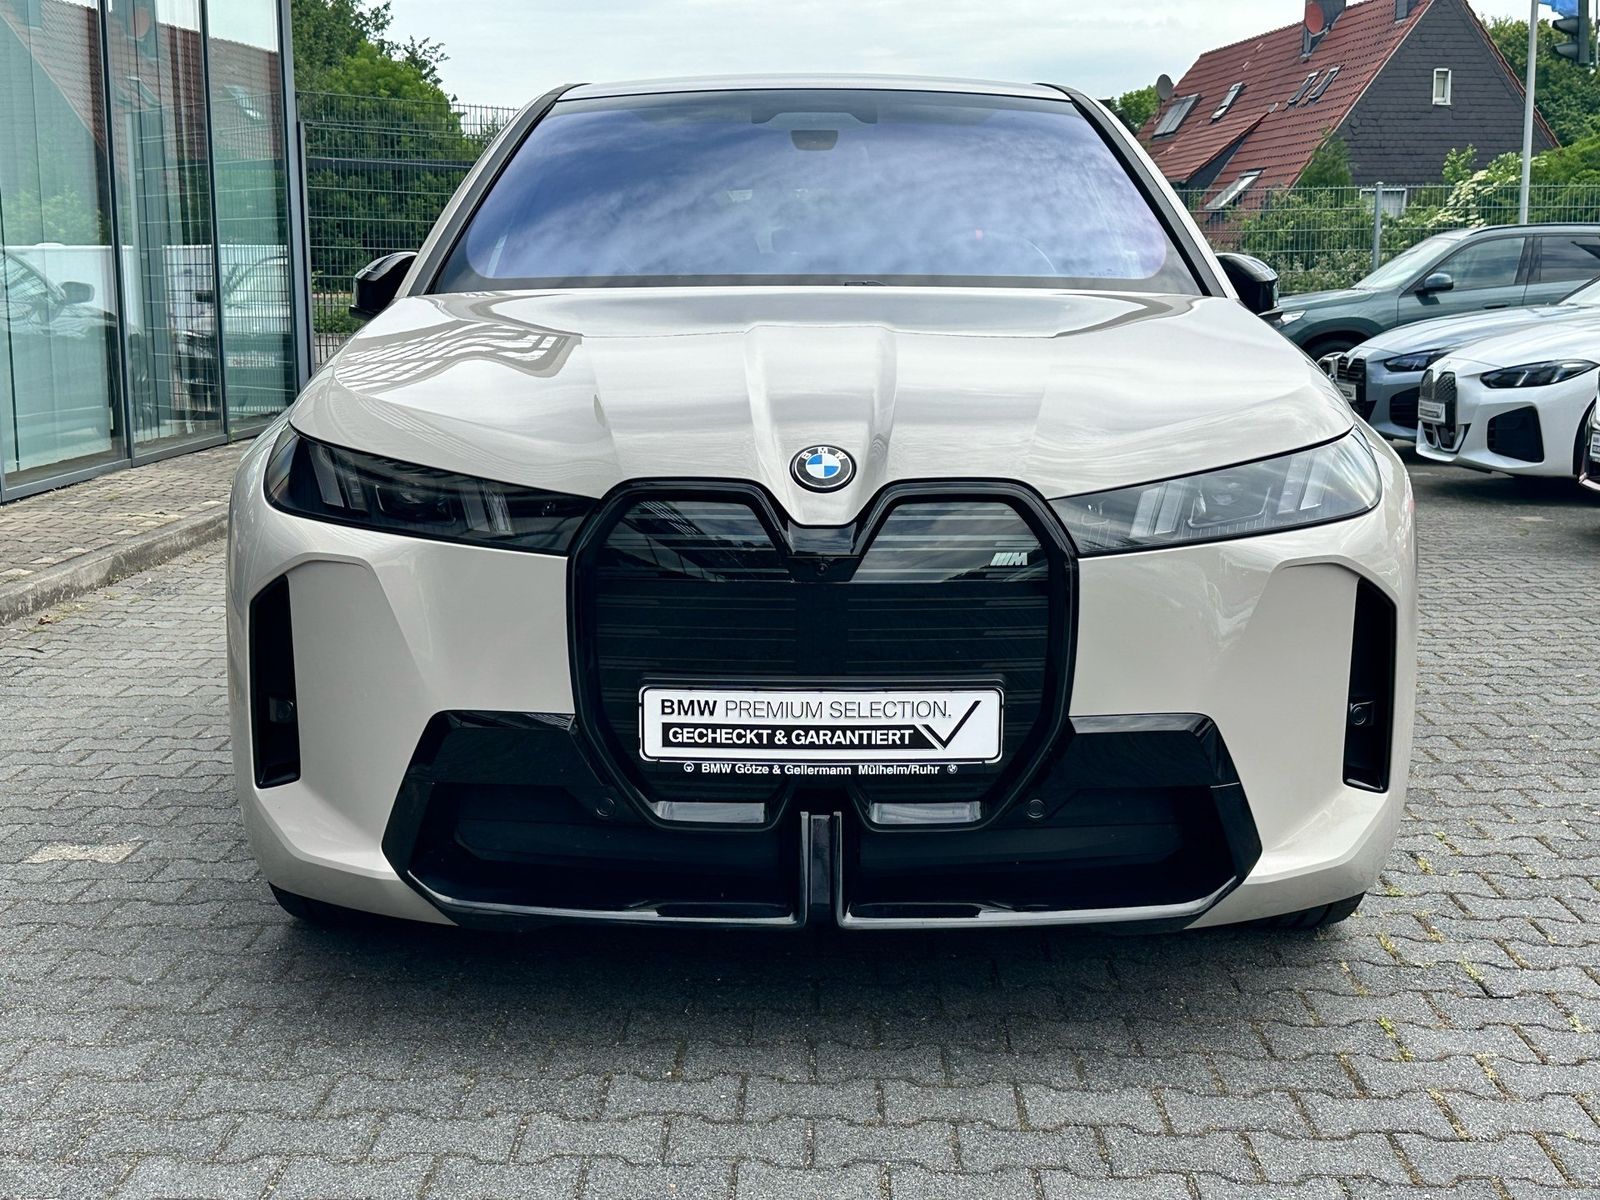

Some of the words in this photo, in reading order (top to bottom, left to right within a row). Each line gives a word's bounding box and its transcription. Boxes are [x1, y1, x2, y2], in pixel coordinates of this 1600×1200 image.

[801, 447, 847, 460] BMW
[660, 699, 718, 717] BMW
[725, 700, 823, 719] PREMIUM
[829, 700, 952, 719] SELECTION.
[668, 727, 772, 745] GECHECKT
[774, 730, 788, 745] &
[791, 729, 914, 745] GARANTIERT
[701, 763, 732, 774] BMW
[735, 763, 769, 774] Götze
[772, 764, 781, 774] &
[784, 764, 852, 775] Gellermann
[858, 764, 940, 775] Mülheim/Ruhr
